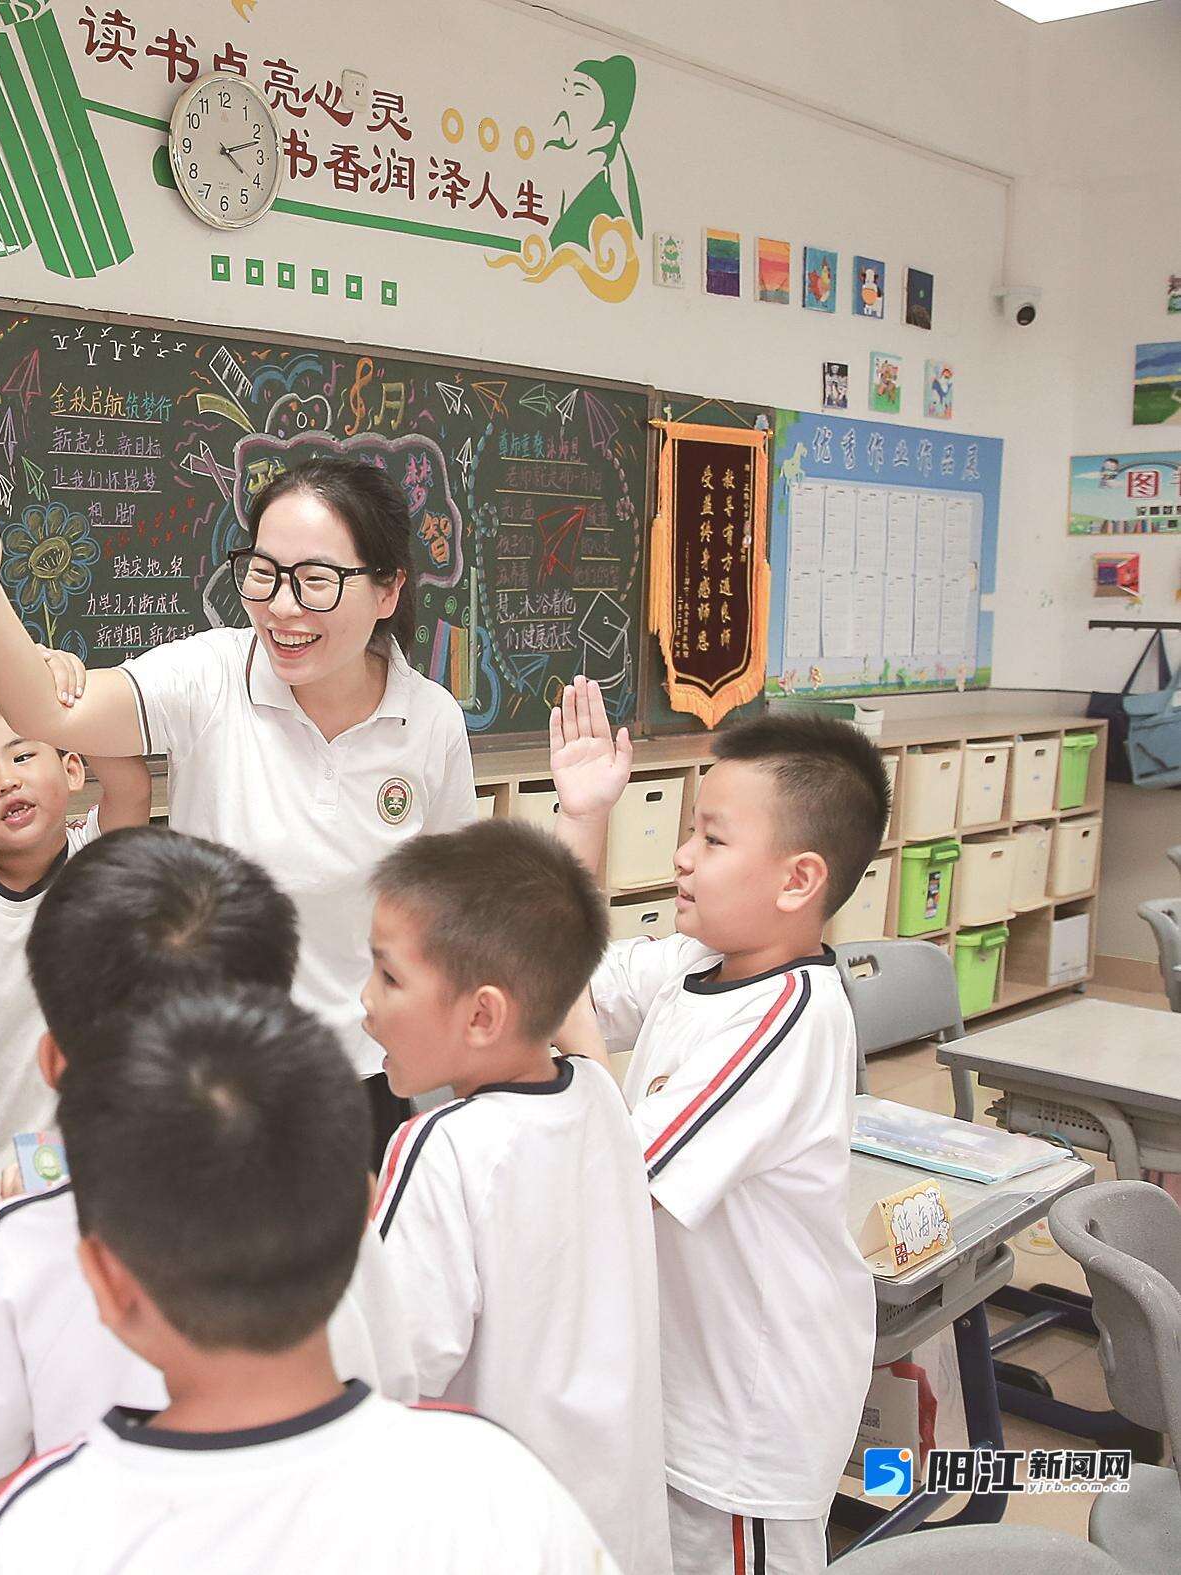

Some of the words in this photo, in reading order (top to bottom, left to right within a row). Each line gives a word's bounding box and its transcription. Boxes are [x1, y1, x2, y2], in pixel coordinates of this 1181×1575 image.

[199, 98, 209, 114] 11
[218, 92, 231, 108] 12
[186, 113, 200, 129] 10
[242, 105, 248, 121] 1
[252, 124, 261, 140] 2
[182, 138, 192, 153] 9
[256, 150, 265, 165] 3
[189, 163, 198, 179] 8
[281, 127, 550, 226] 书香润泽人生
[252, 173, 261, 189] 4
[202, 184, 212, 199] 7
[240, 189, 249, 204] 5
[220, 195, 229, 211] 6
[49, 382, 173, 421] 金秋启航筑梦行
